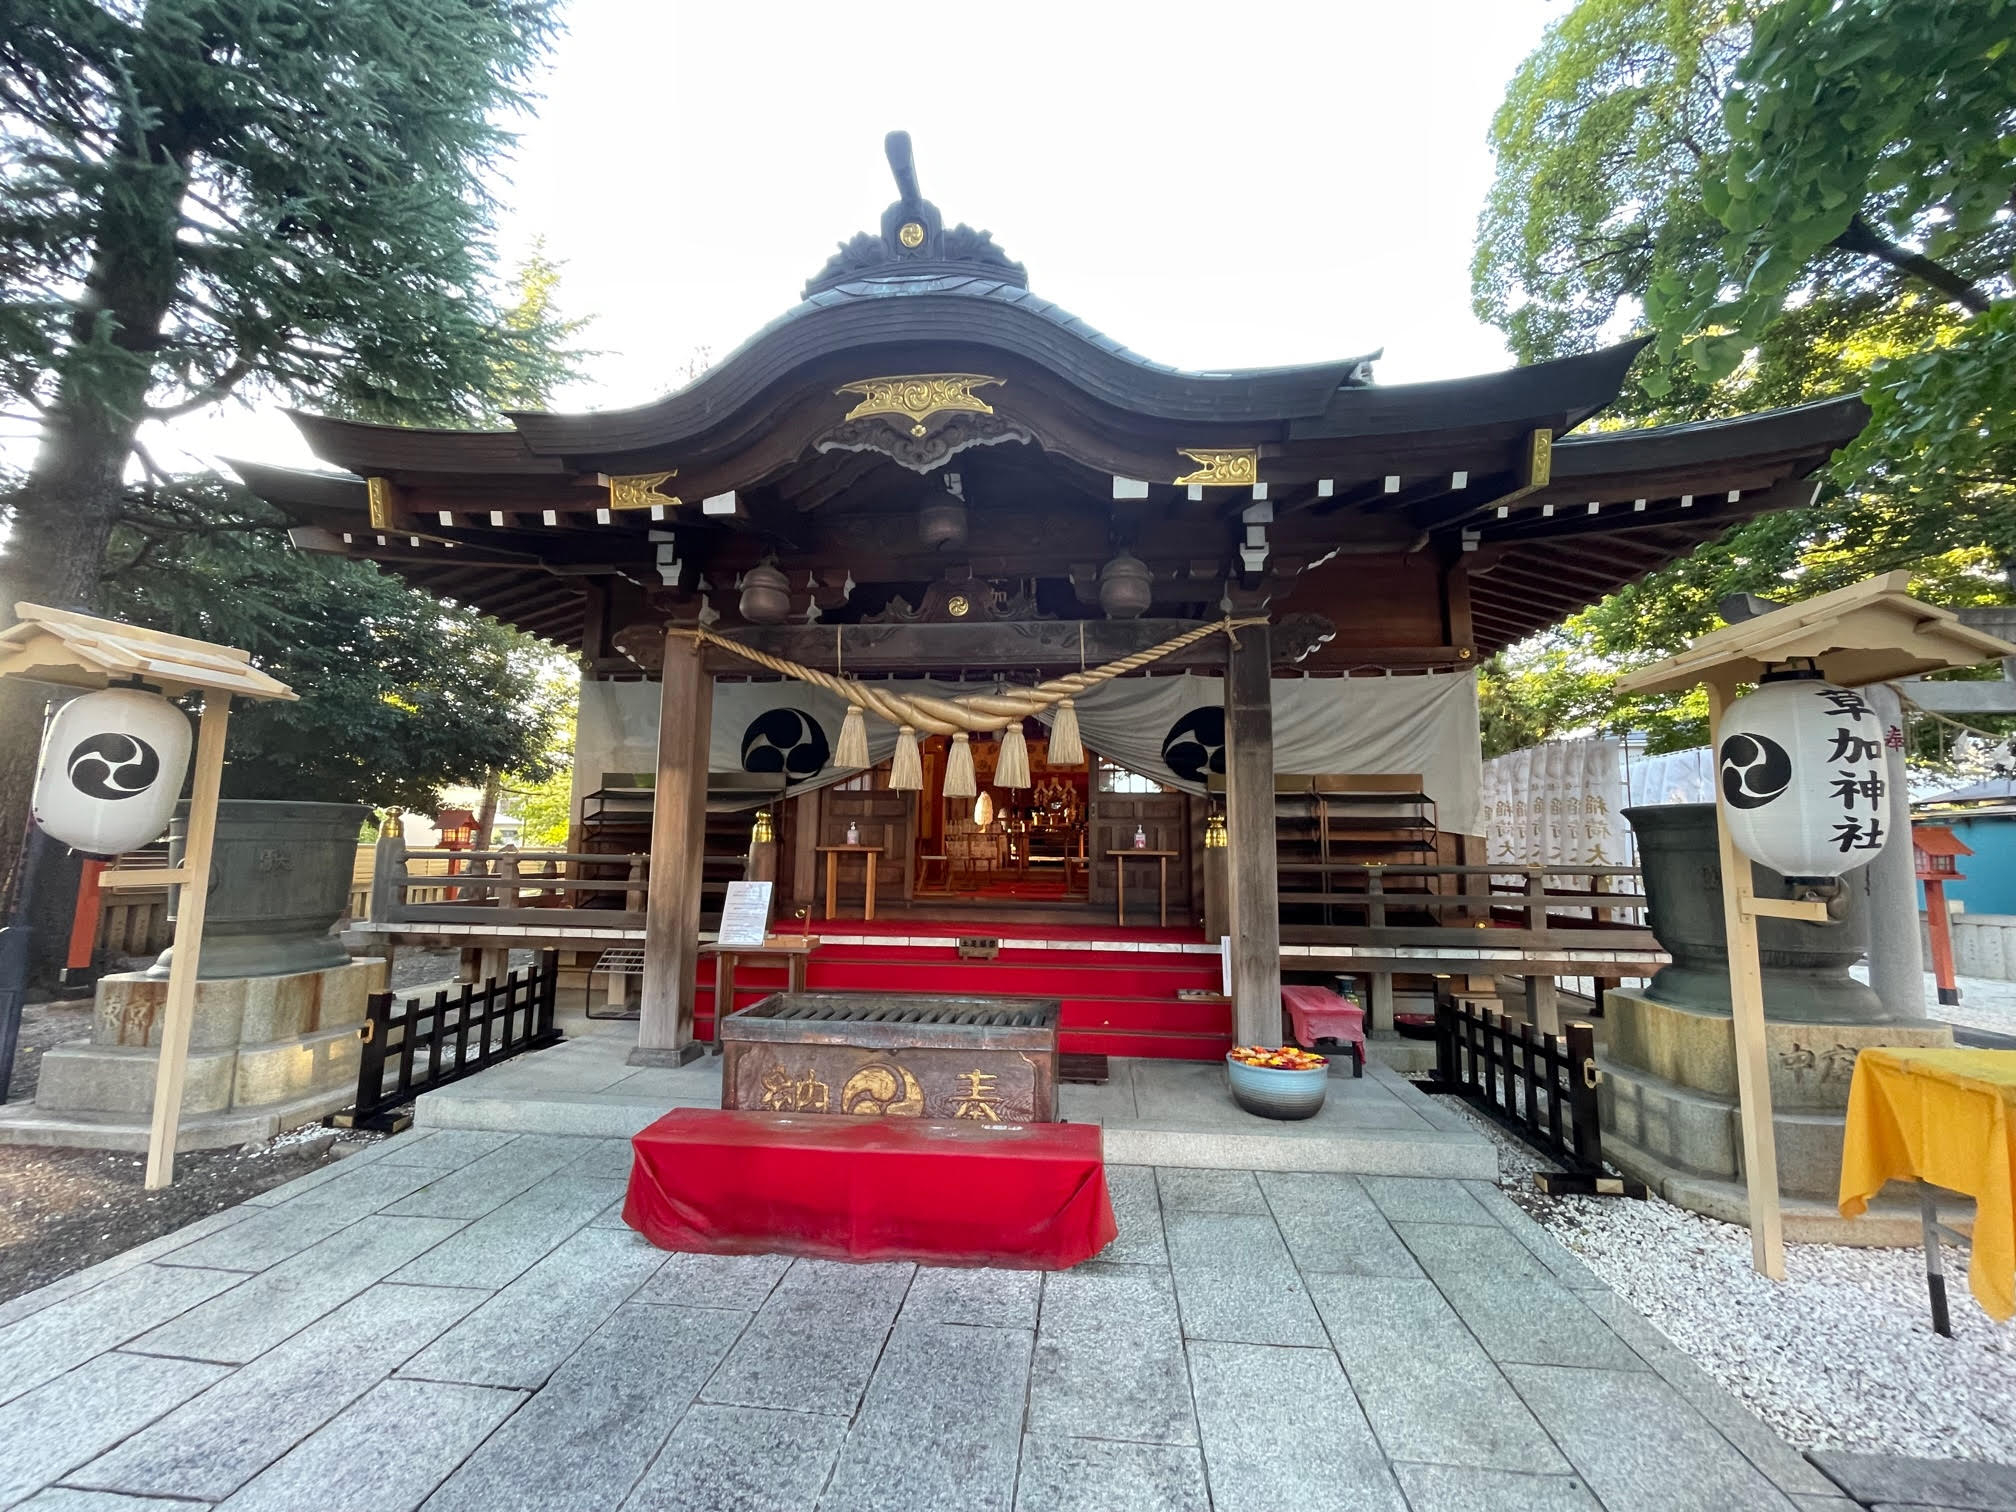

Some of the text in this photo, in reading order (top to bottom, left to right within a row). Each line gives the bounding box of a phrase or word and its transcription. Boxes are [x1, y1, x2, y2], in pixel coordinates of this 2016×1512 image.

[1815, 689, 1886, 853] 草加神社
[951, 1068, 1003, 1121] 奉
